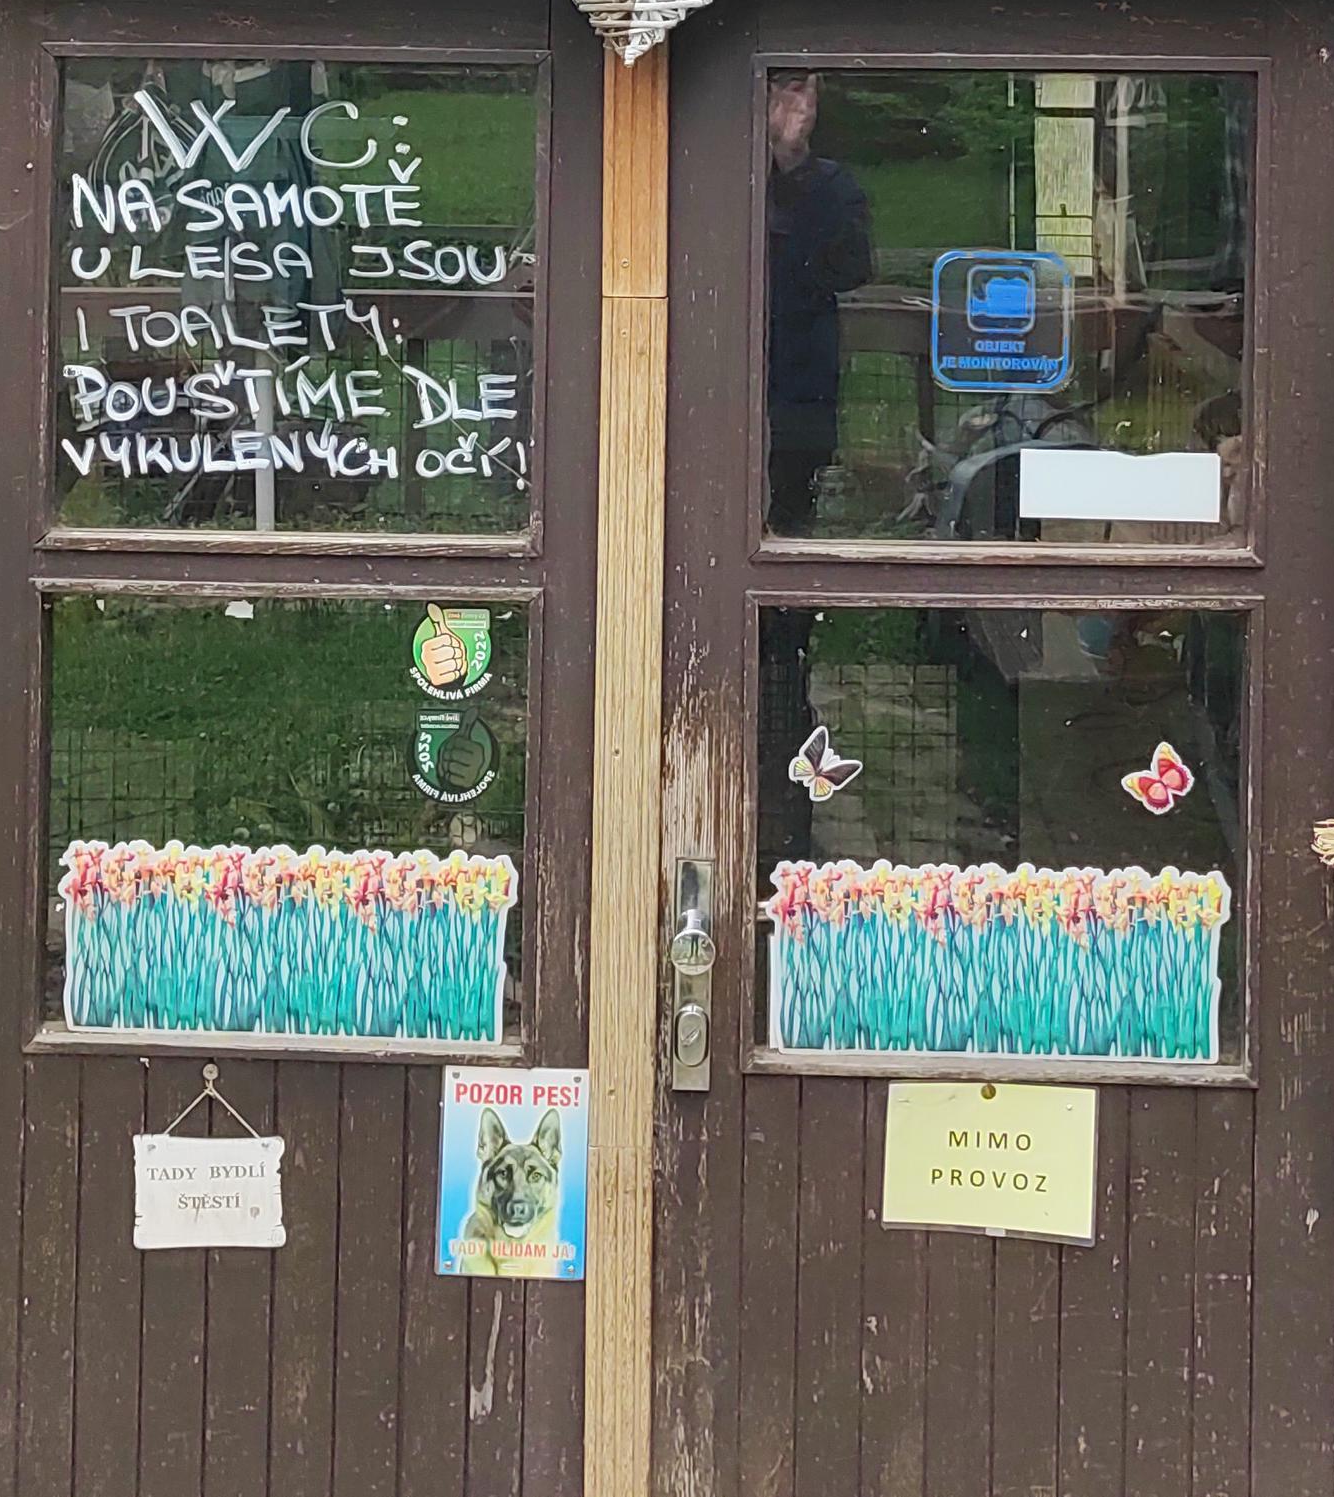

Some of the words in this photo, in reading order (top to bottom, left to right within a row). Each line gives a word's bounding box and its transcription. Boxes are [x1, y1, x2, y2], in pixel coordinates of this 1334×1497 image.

[71, 172, 161, 234] NA
[176, 157, 423, 233] SAMOTĚ
[71, 246, 111, 281] U
[129, 242, 315, 281] LESA
[348, 239, 509, 284] JSOU
[78, 307, 89, 351] I
[974, 340, 1026, 354] OBJEKT
[940, 356, 957, 369] JE
[63, 356, 392, 422] POUŠTÍME
[401, 364, 518, 429] DLE
[61, 419, 398, 479] VYKULENÝCH
[470, 631, 486, 672] 2022
[409, 666, 464, 700] SPOLEHLIVÁ
[464, 672, 493, 697] FIRMA
[455, 1083, 523, 1105] POZOR
[533, 1085, 580, 1107] PES!
[949, 1130, 1032, 1152] MIMO
[146, 1167, 198, 1181] TADY
[209, 1161, 266, 1179] BYDLÍ
[931, 1168, 1048, 1193] PROVOZ
[177, 1192, 241, 1210] ŠTĚSTÍ
